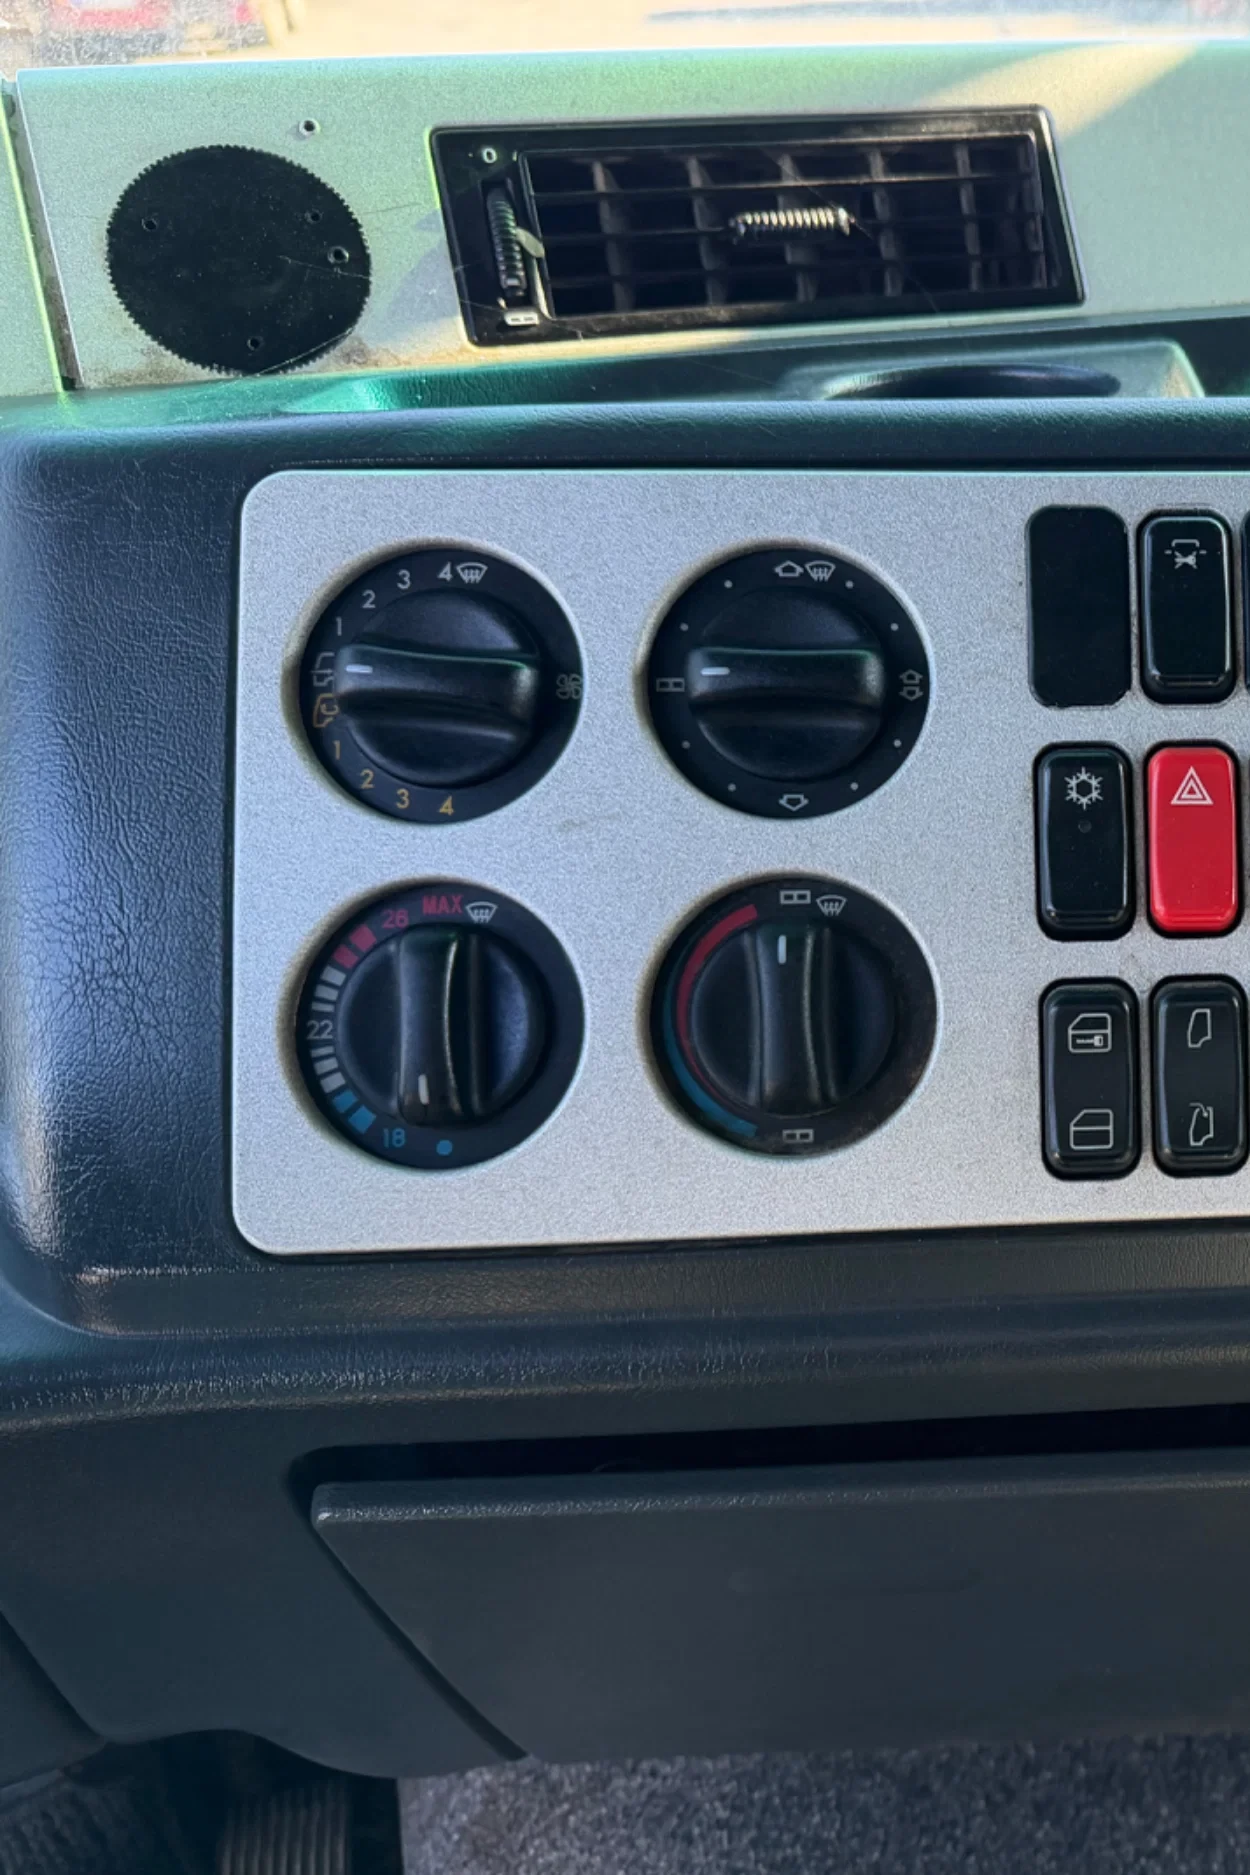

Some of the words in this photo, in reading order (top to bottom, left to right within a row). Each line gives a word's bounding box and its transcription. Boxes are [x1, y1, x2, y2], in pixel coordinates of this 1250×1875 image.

[335, 616, 342, 636] 1
[362, 590, 376, 608] 2
[397, 569, 411, 589] 3
[437, 562, 453, 581] 4
[332, 740, 341, 760] 1
[360, 769, 374, 789] 2
[396, 788, 410, 809] 3
[439, 796, 455, 815] 4
[423, 895, 463, 914] MAX
[306, 1020, 333, 1039] 22
[383, 1128, 405, 1148] 18
